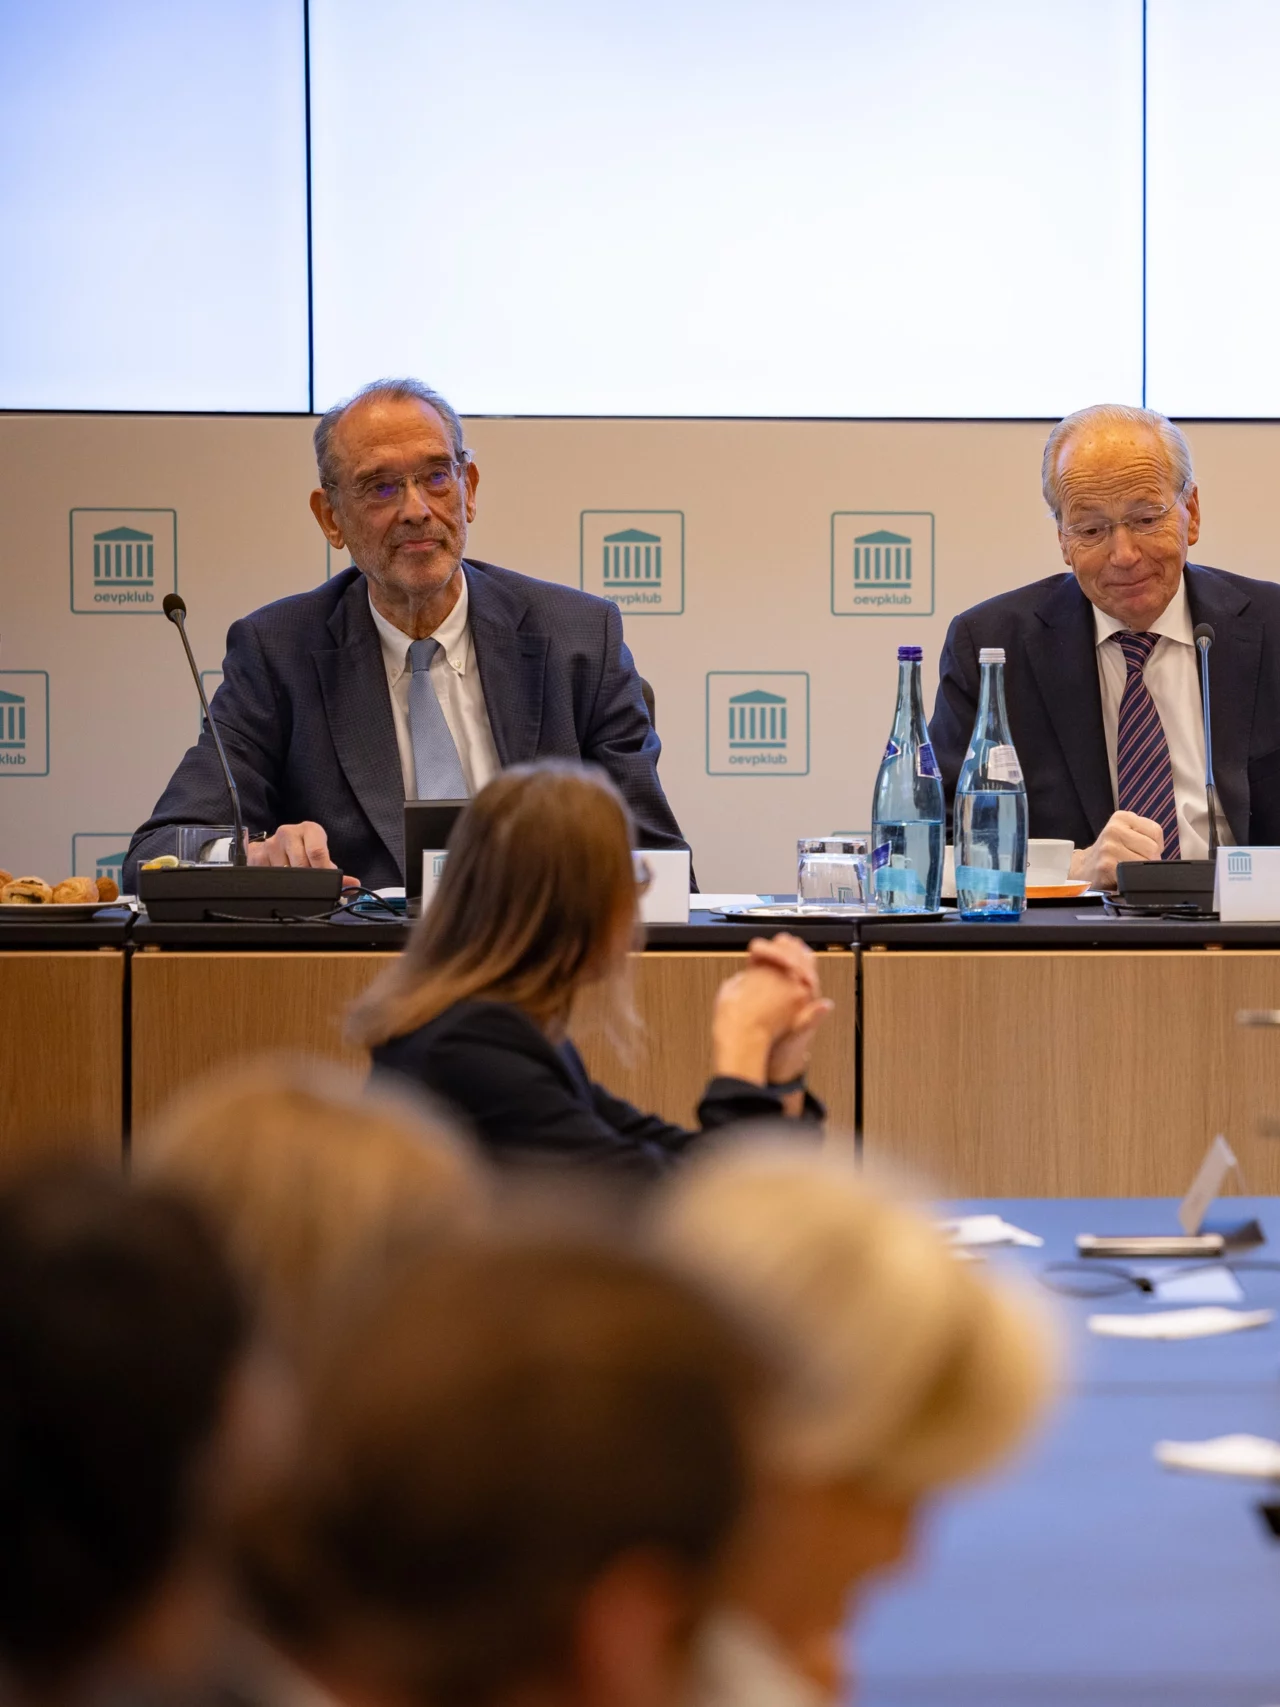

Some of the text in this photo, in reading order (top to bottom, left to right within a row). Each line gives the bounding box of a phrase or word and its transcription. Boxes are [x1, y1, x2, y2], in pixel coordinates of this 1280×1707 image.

[94, 591, 154, 605] oevpklub
[854, 594, 912, 607] oevpklub
[728, 753, 787, 766] oevpklub
